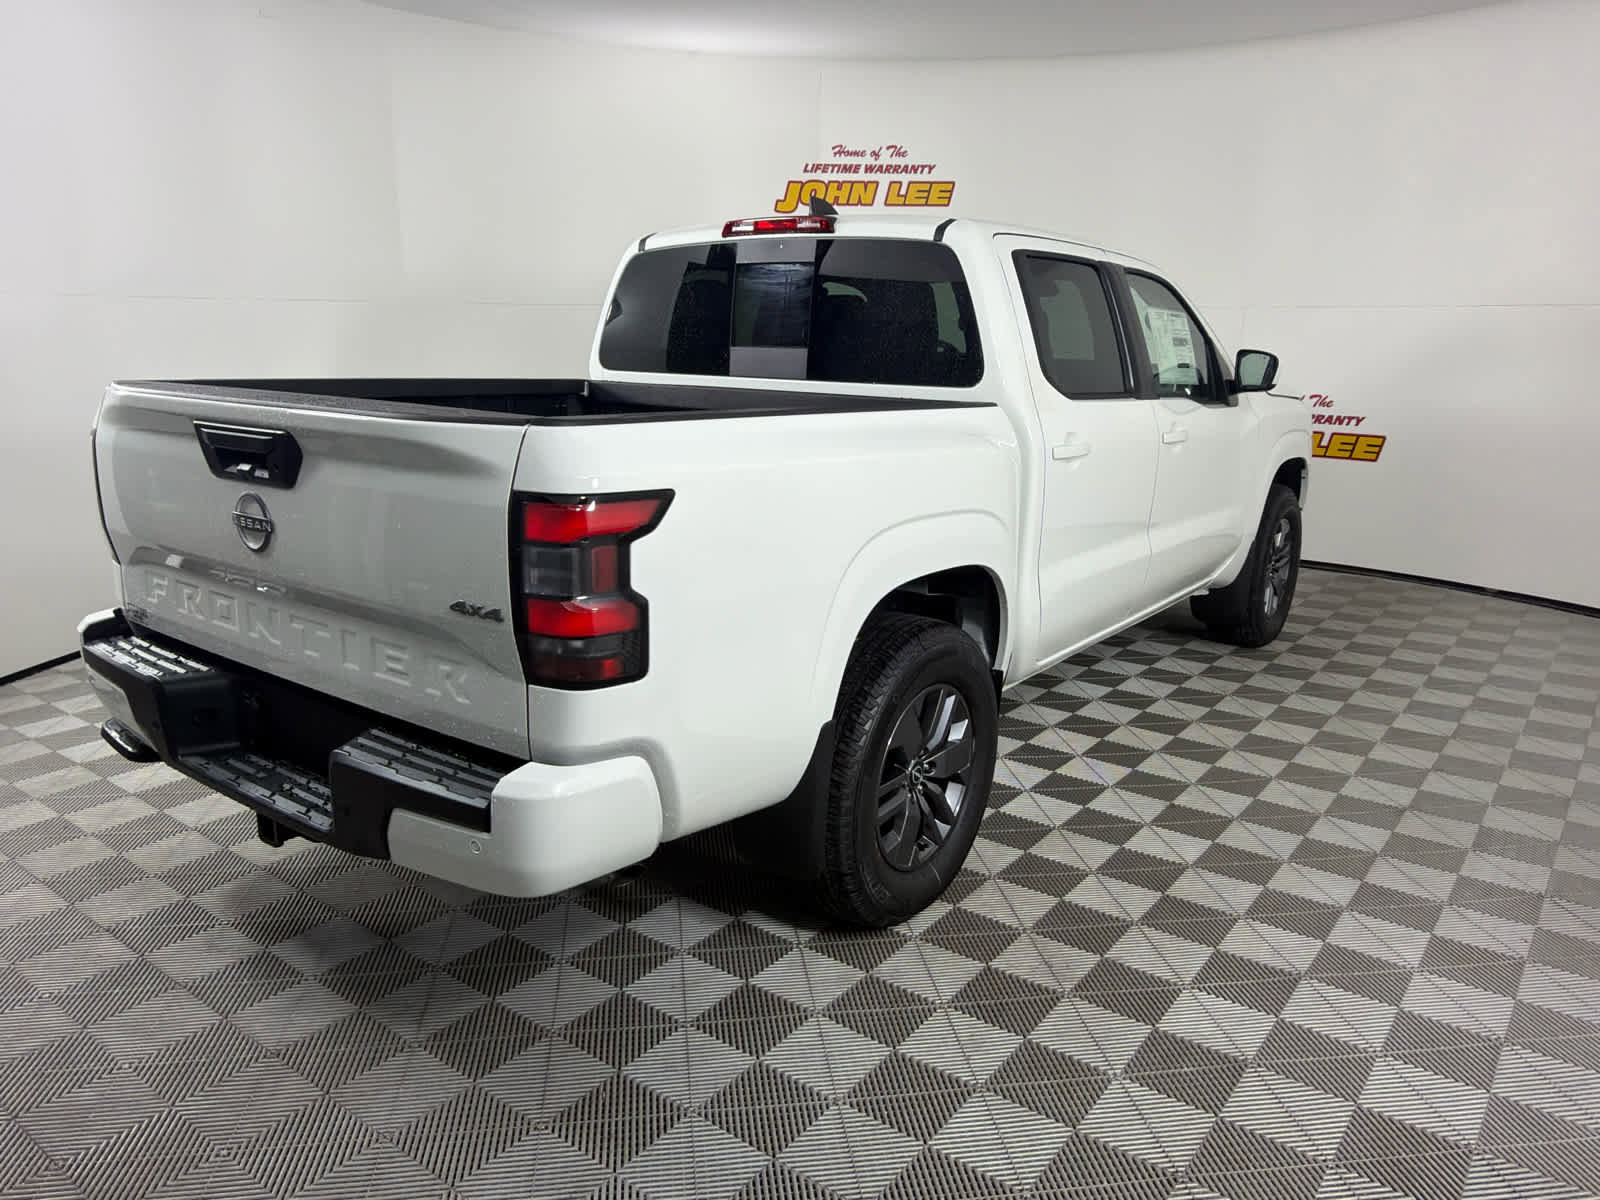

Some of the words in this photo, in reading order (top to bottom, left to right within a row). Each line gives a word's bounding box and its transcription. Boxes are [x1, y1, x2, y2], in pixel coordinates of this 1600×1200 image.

[832, 144, 867, 158] Home
[870, 146, 883, 161] of
[886, 145, 908, 158] The
[803, 163, 861, 174] LIFETIME
[864, 164, 936, 175] WARRANTY
[774, 180, 879, 213] JOHN
[884, 181, 955, 206] LEE
[1309, 394, 1334, 408] The
[1312, 431, 1386, 462] LEE
[232, 515, 272, 532] SSAN
[146, 571, 471, 704] FRONTIER
